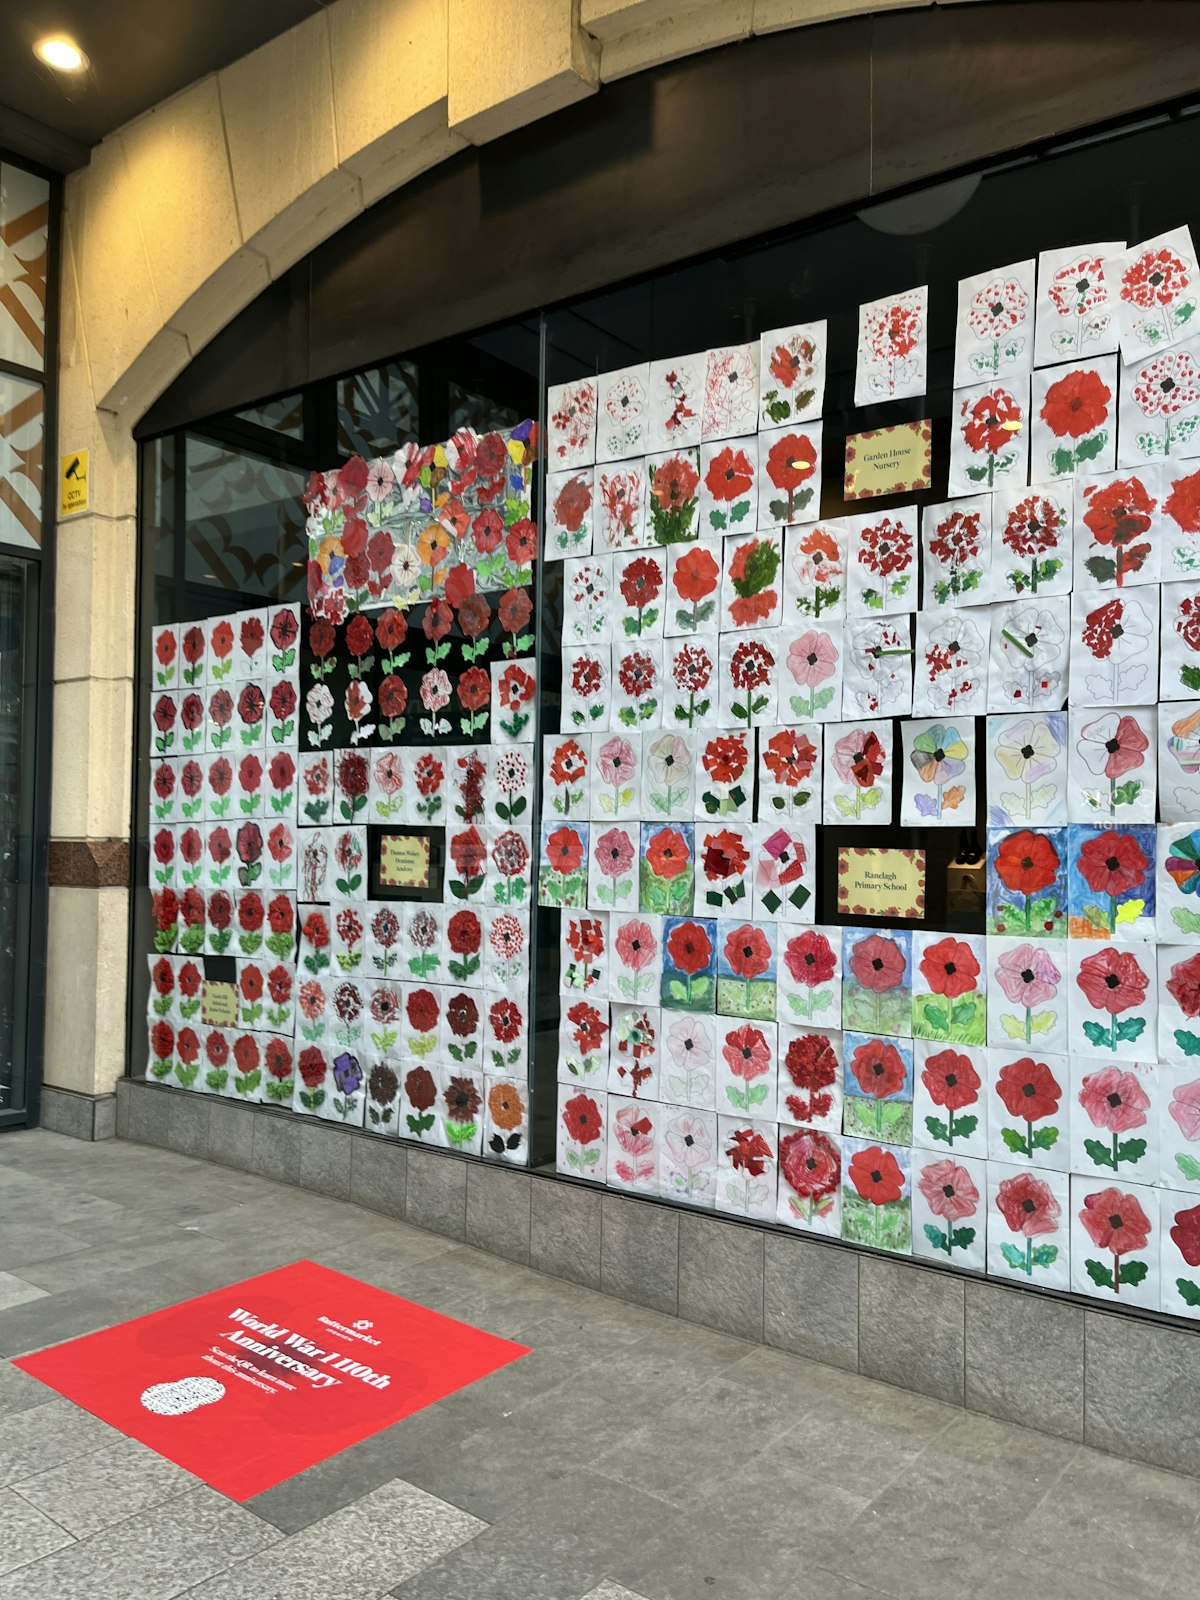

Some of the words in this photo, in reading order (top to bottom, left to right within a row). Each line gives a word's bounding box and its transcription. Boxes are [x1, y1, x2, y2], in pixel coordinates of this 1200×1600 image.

[864, 452, 888, 462] Garden
[890, 448, 911, 457] House
[874, 460, 900, 470] Nursery
[67, 489, 81, 499] CCTV
[864, 872, 896, 881] Ranelagh
[854, 881, 882, 892] Primary
[883, 882, 907, 891] School
[317, 1316, 382, 1346] Buttermarket
[228, 1308, 290, 1339] World
[283, 1333, 326, 1357] War
[331, 1357, 391, 1390] 110th
[201, 1355, 224, 1367] about
[221, 1364, 237, 1374] this
[218, 1330, 343, 1389] Anniversary
[209, 1346, 227, 1357] Scan
[225, 1354, 238, 1363] the
[237, 1360, 253, 1369] QR
[257, 1369, 278, 1382] learn
[275, 1379, 297, 1391] more
